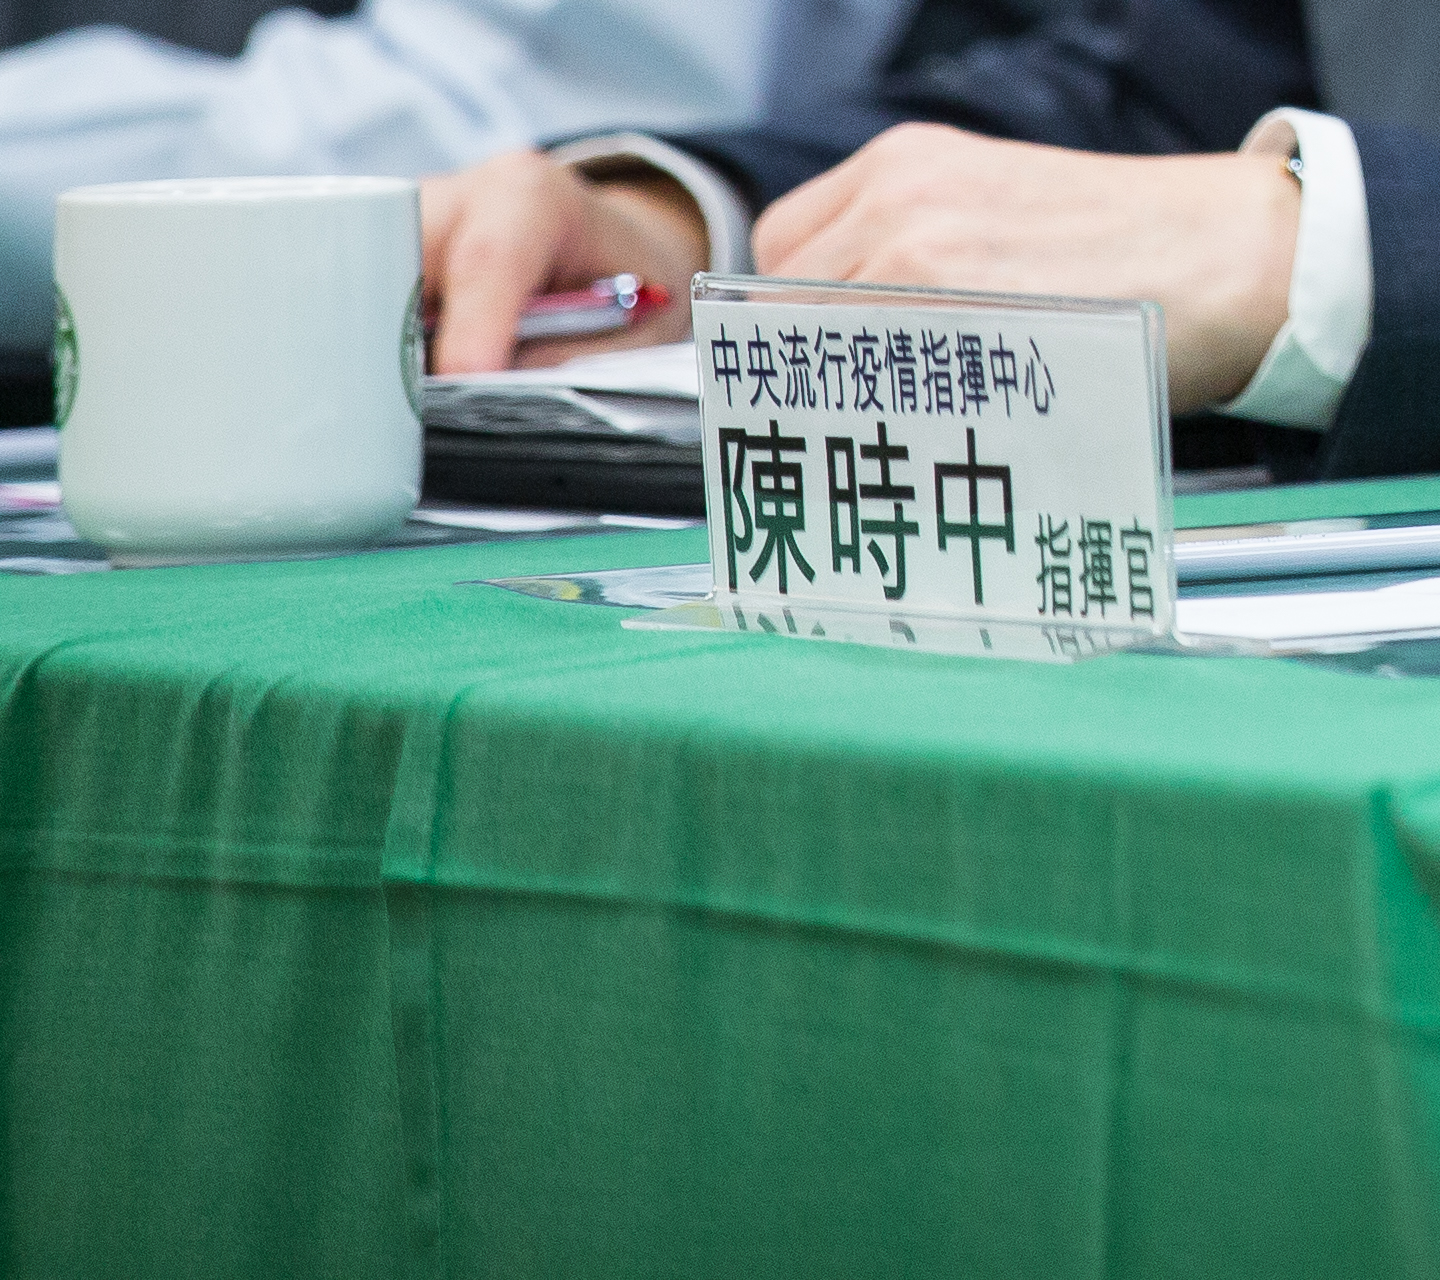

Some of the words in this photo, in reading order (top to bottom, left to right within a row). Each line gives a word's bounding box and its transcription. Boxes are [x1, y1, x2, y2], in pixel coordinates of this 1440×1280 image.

[709, 322, 1056, 418] 中央流行疫情指揮中心
[717, 418, 1017, 606] 陳時中
[1033, 511, 1156, 619] 指揮官
